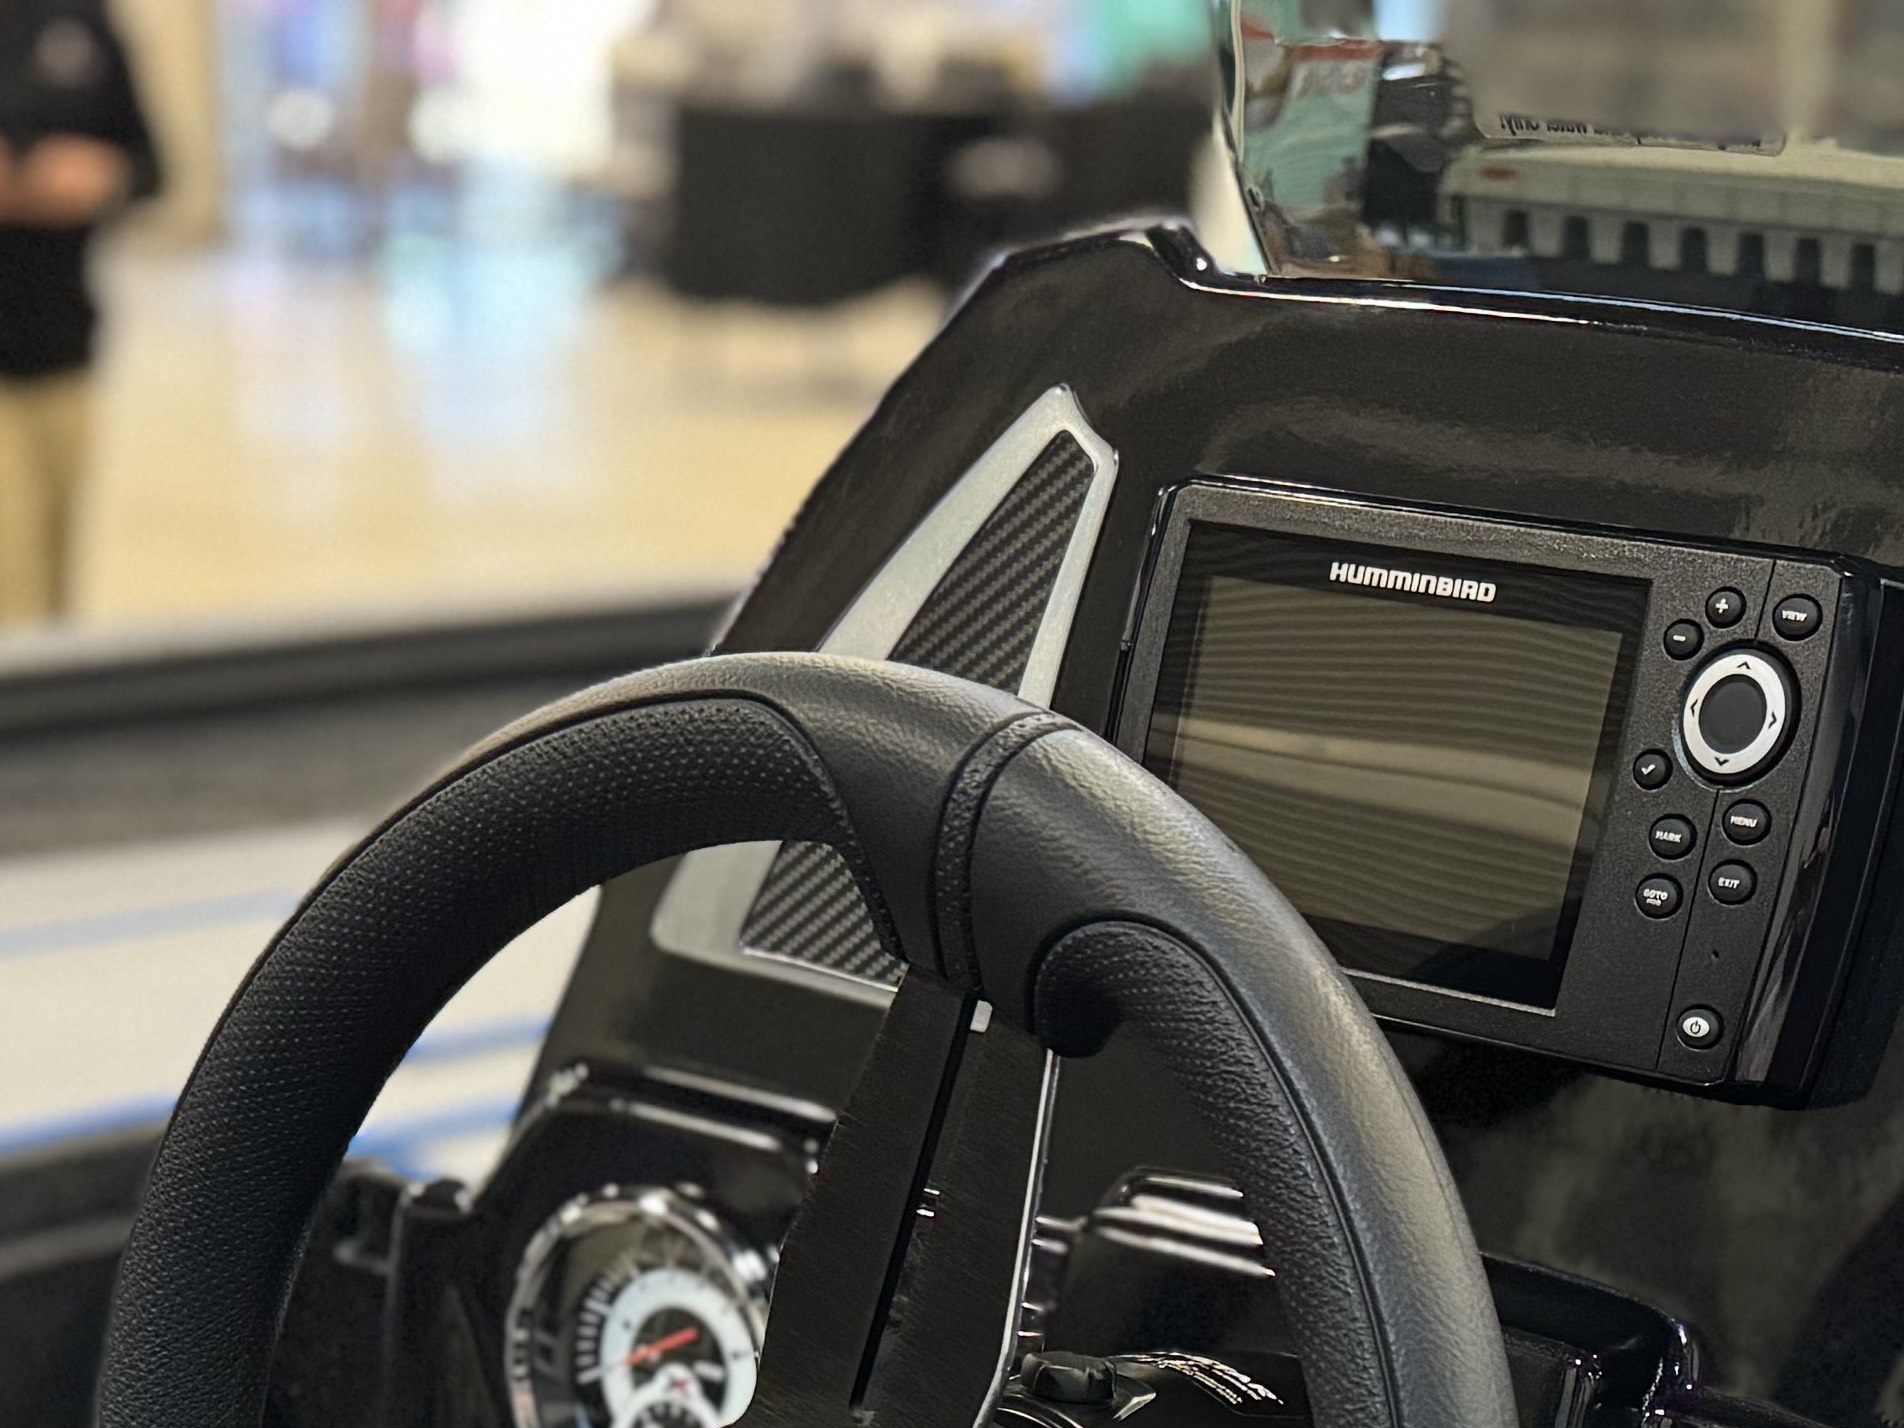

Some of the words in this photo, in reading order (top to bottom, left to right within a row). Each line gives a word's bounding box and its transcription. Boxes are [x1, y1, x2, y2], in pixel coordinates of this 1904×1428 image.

[1329, 561, 1497, 603] HUMMINBIRD
[1781, 609, 1809, 623] VIEW
[1730, 815, 1758, 829] MENU
[1655, 830, 1682, 843] MARK
[1718, 876, 1740, 889] EXIT
[1643, 888, 1669, 901] GOTO
